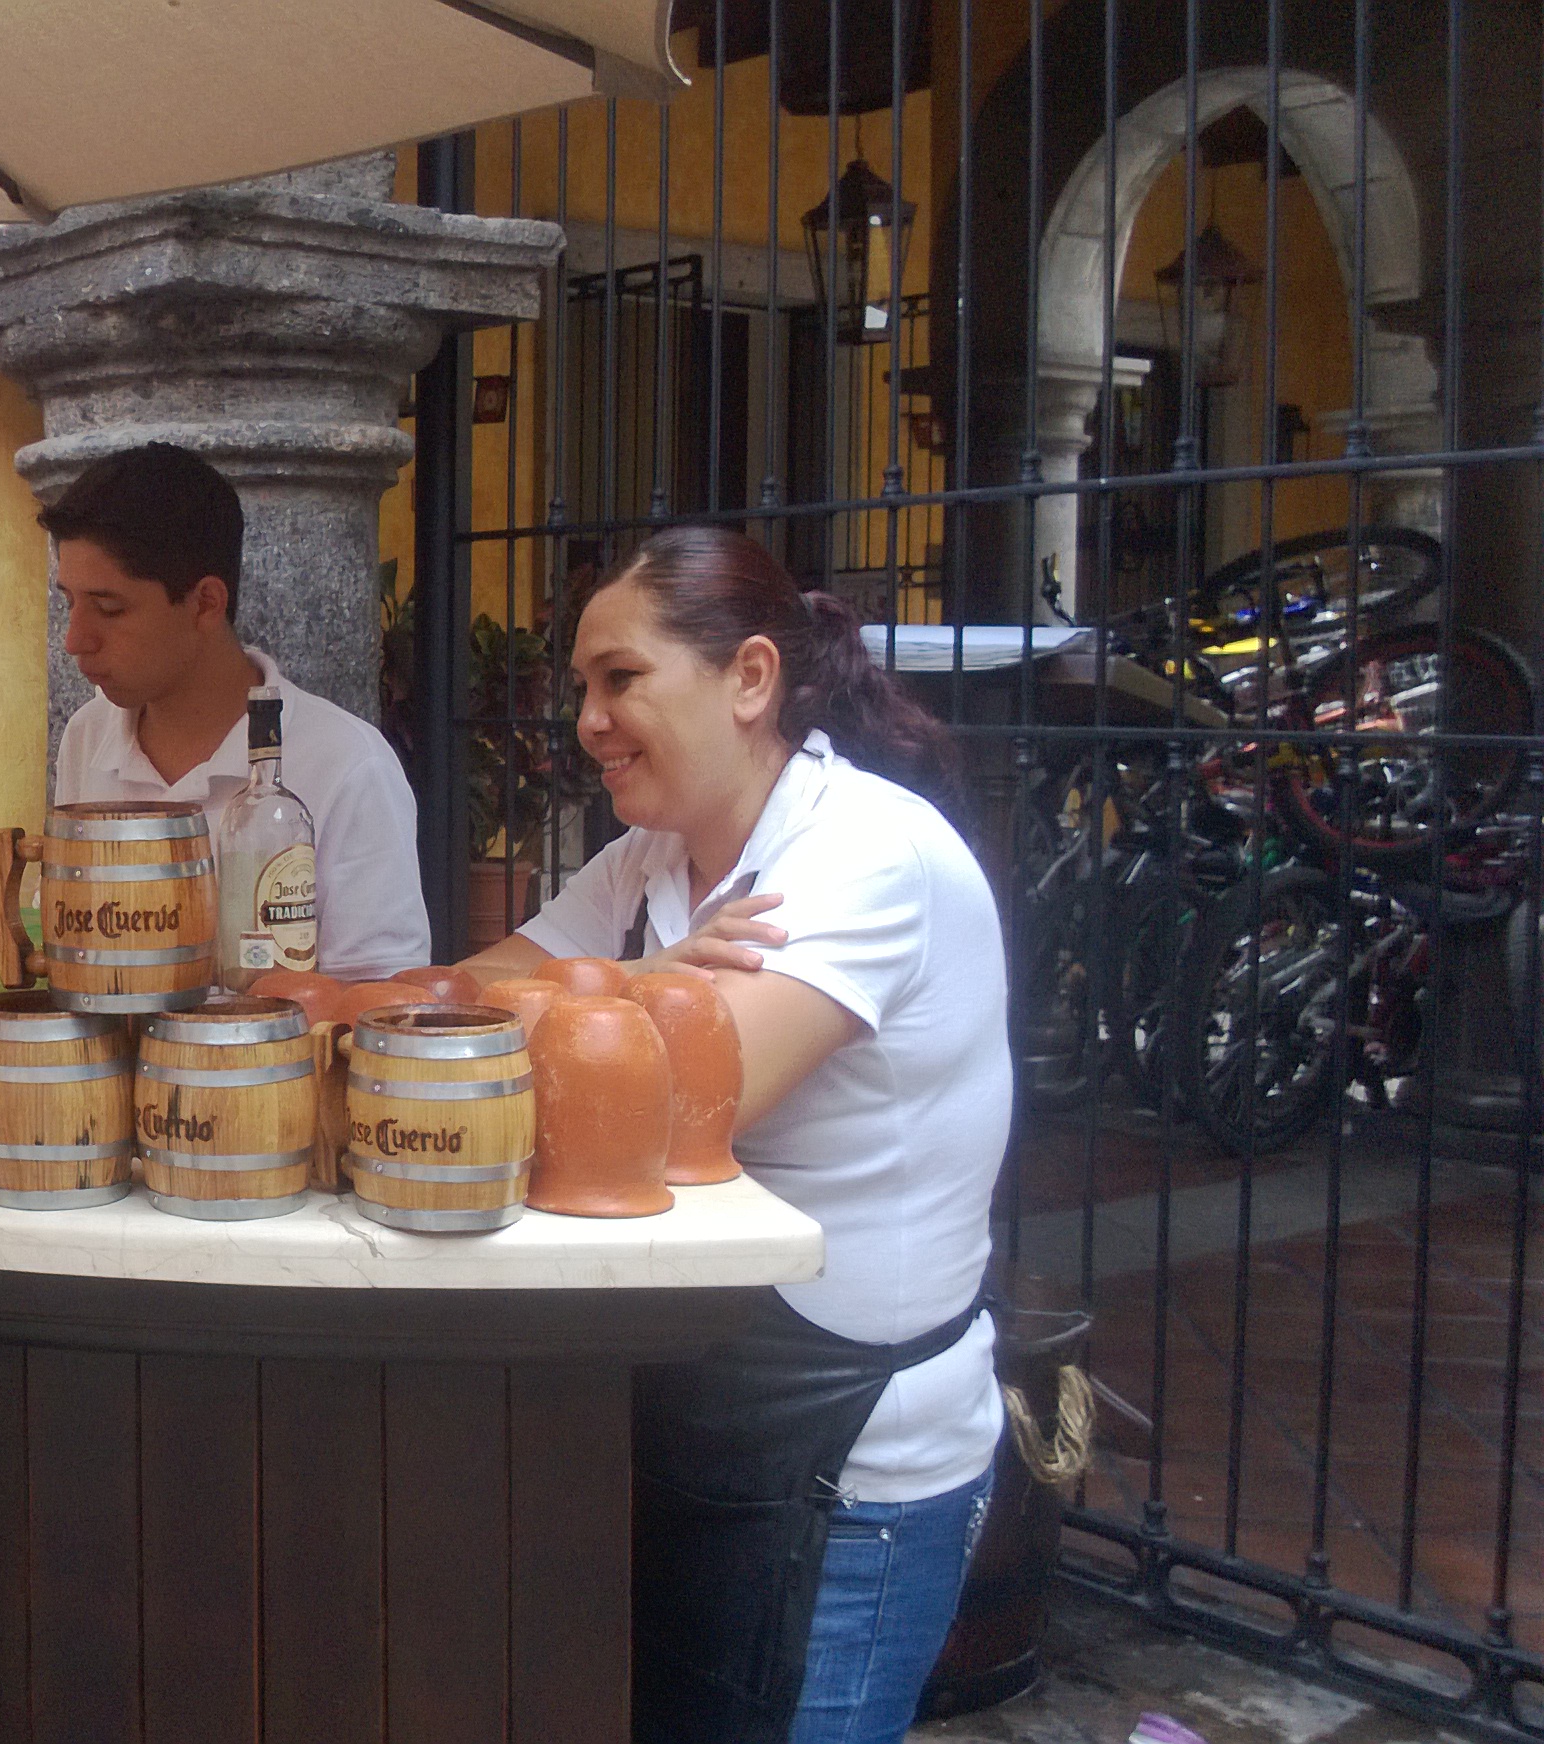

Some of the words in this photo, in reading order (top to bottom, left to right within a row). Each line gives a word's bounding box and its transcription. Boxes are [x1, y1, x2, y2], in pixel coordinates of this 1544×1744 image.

[274, 881, 299, 899] Jose
[54, 900, 93, 939] Jose
[97, 900, 180, 939] Cuervo
[143, 1103, 214, 1142] Cuervo
[376, 1118, 462, 1156] Cuervo
